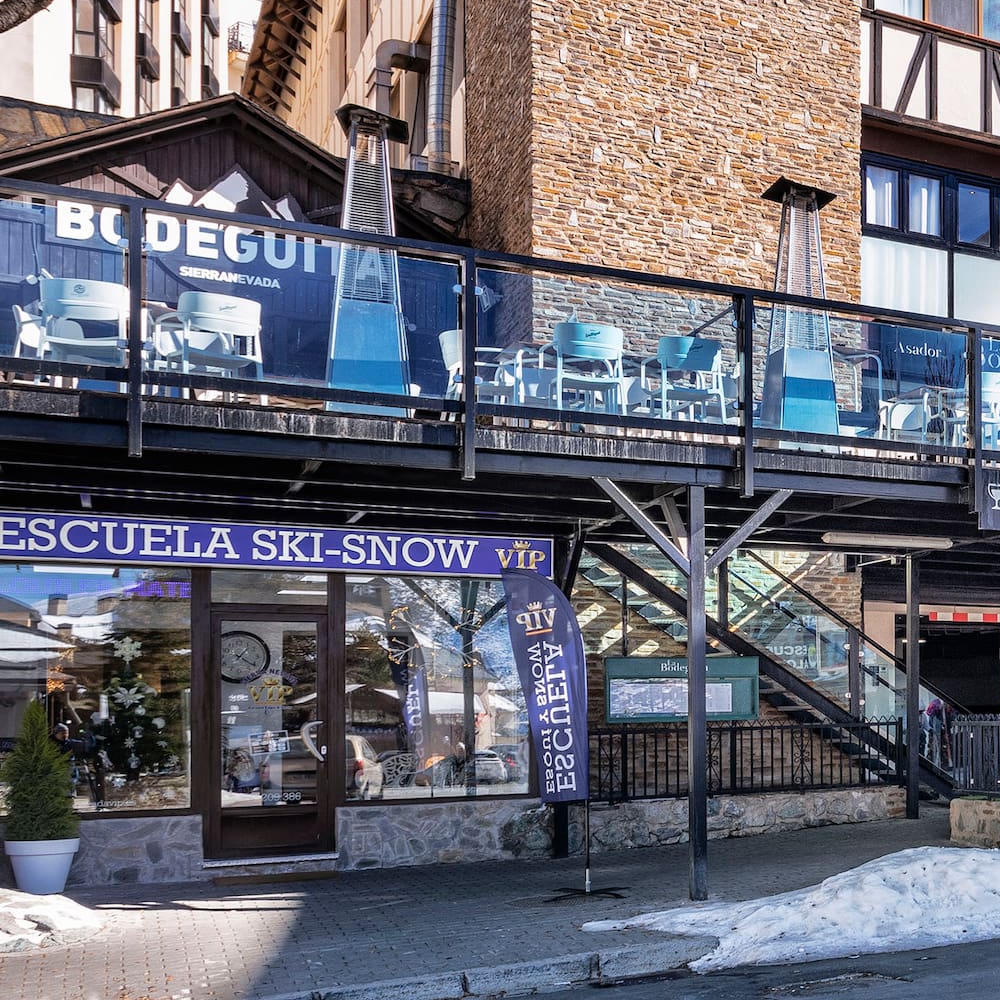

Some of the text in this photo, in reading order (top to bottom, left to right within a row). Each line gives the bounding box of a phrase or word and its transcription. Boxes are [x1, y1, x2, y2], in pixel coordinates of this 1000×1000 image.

[894, 341, 942, 358] Asador
[0, 516, 479, 570] ESCUELA SKI-SNOW
[495, 548, 546, 570] VIP
